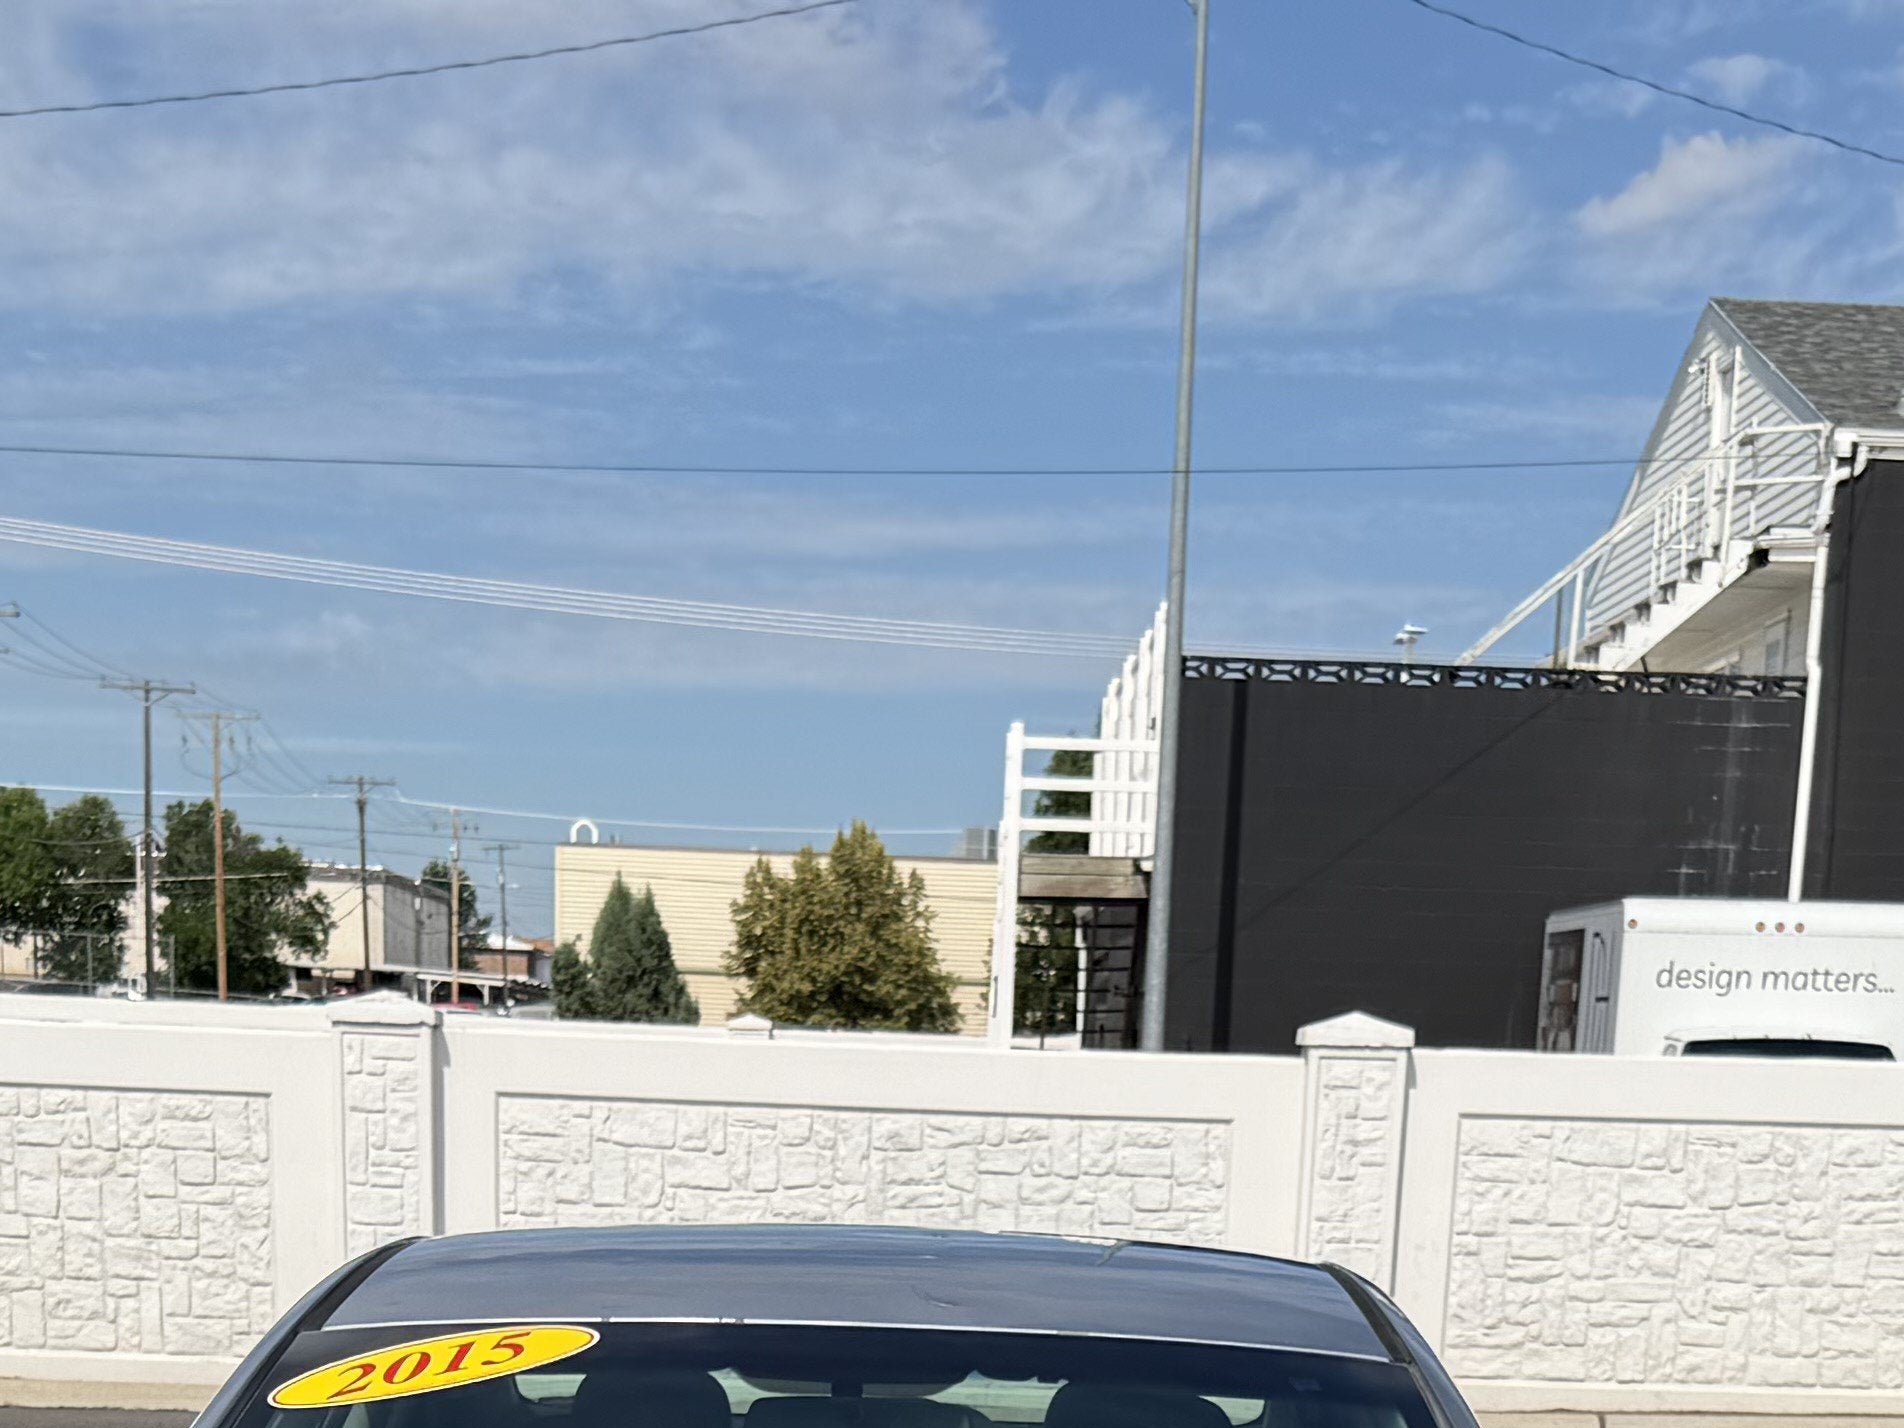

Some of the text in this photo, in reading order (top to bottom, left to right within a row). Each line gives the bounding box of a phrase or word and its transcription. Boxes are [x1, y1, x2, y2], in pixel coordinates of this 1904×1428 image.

[1655, 960, 1896, 997] design matters...
[325, 1331, 532, 1400] 2015
